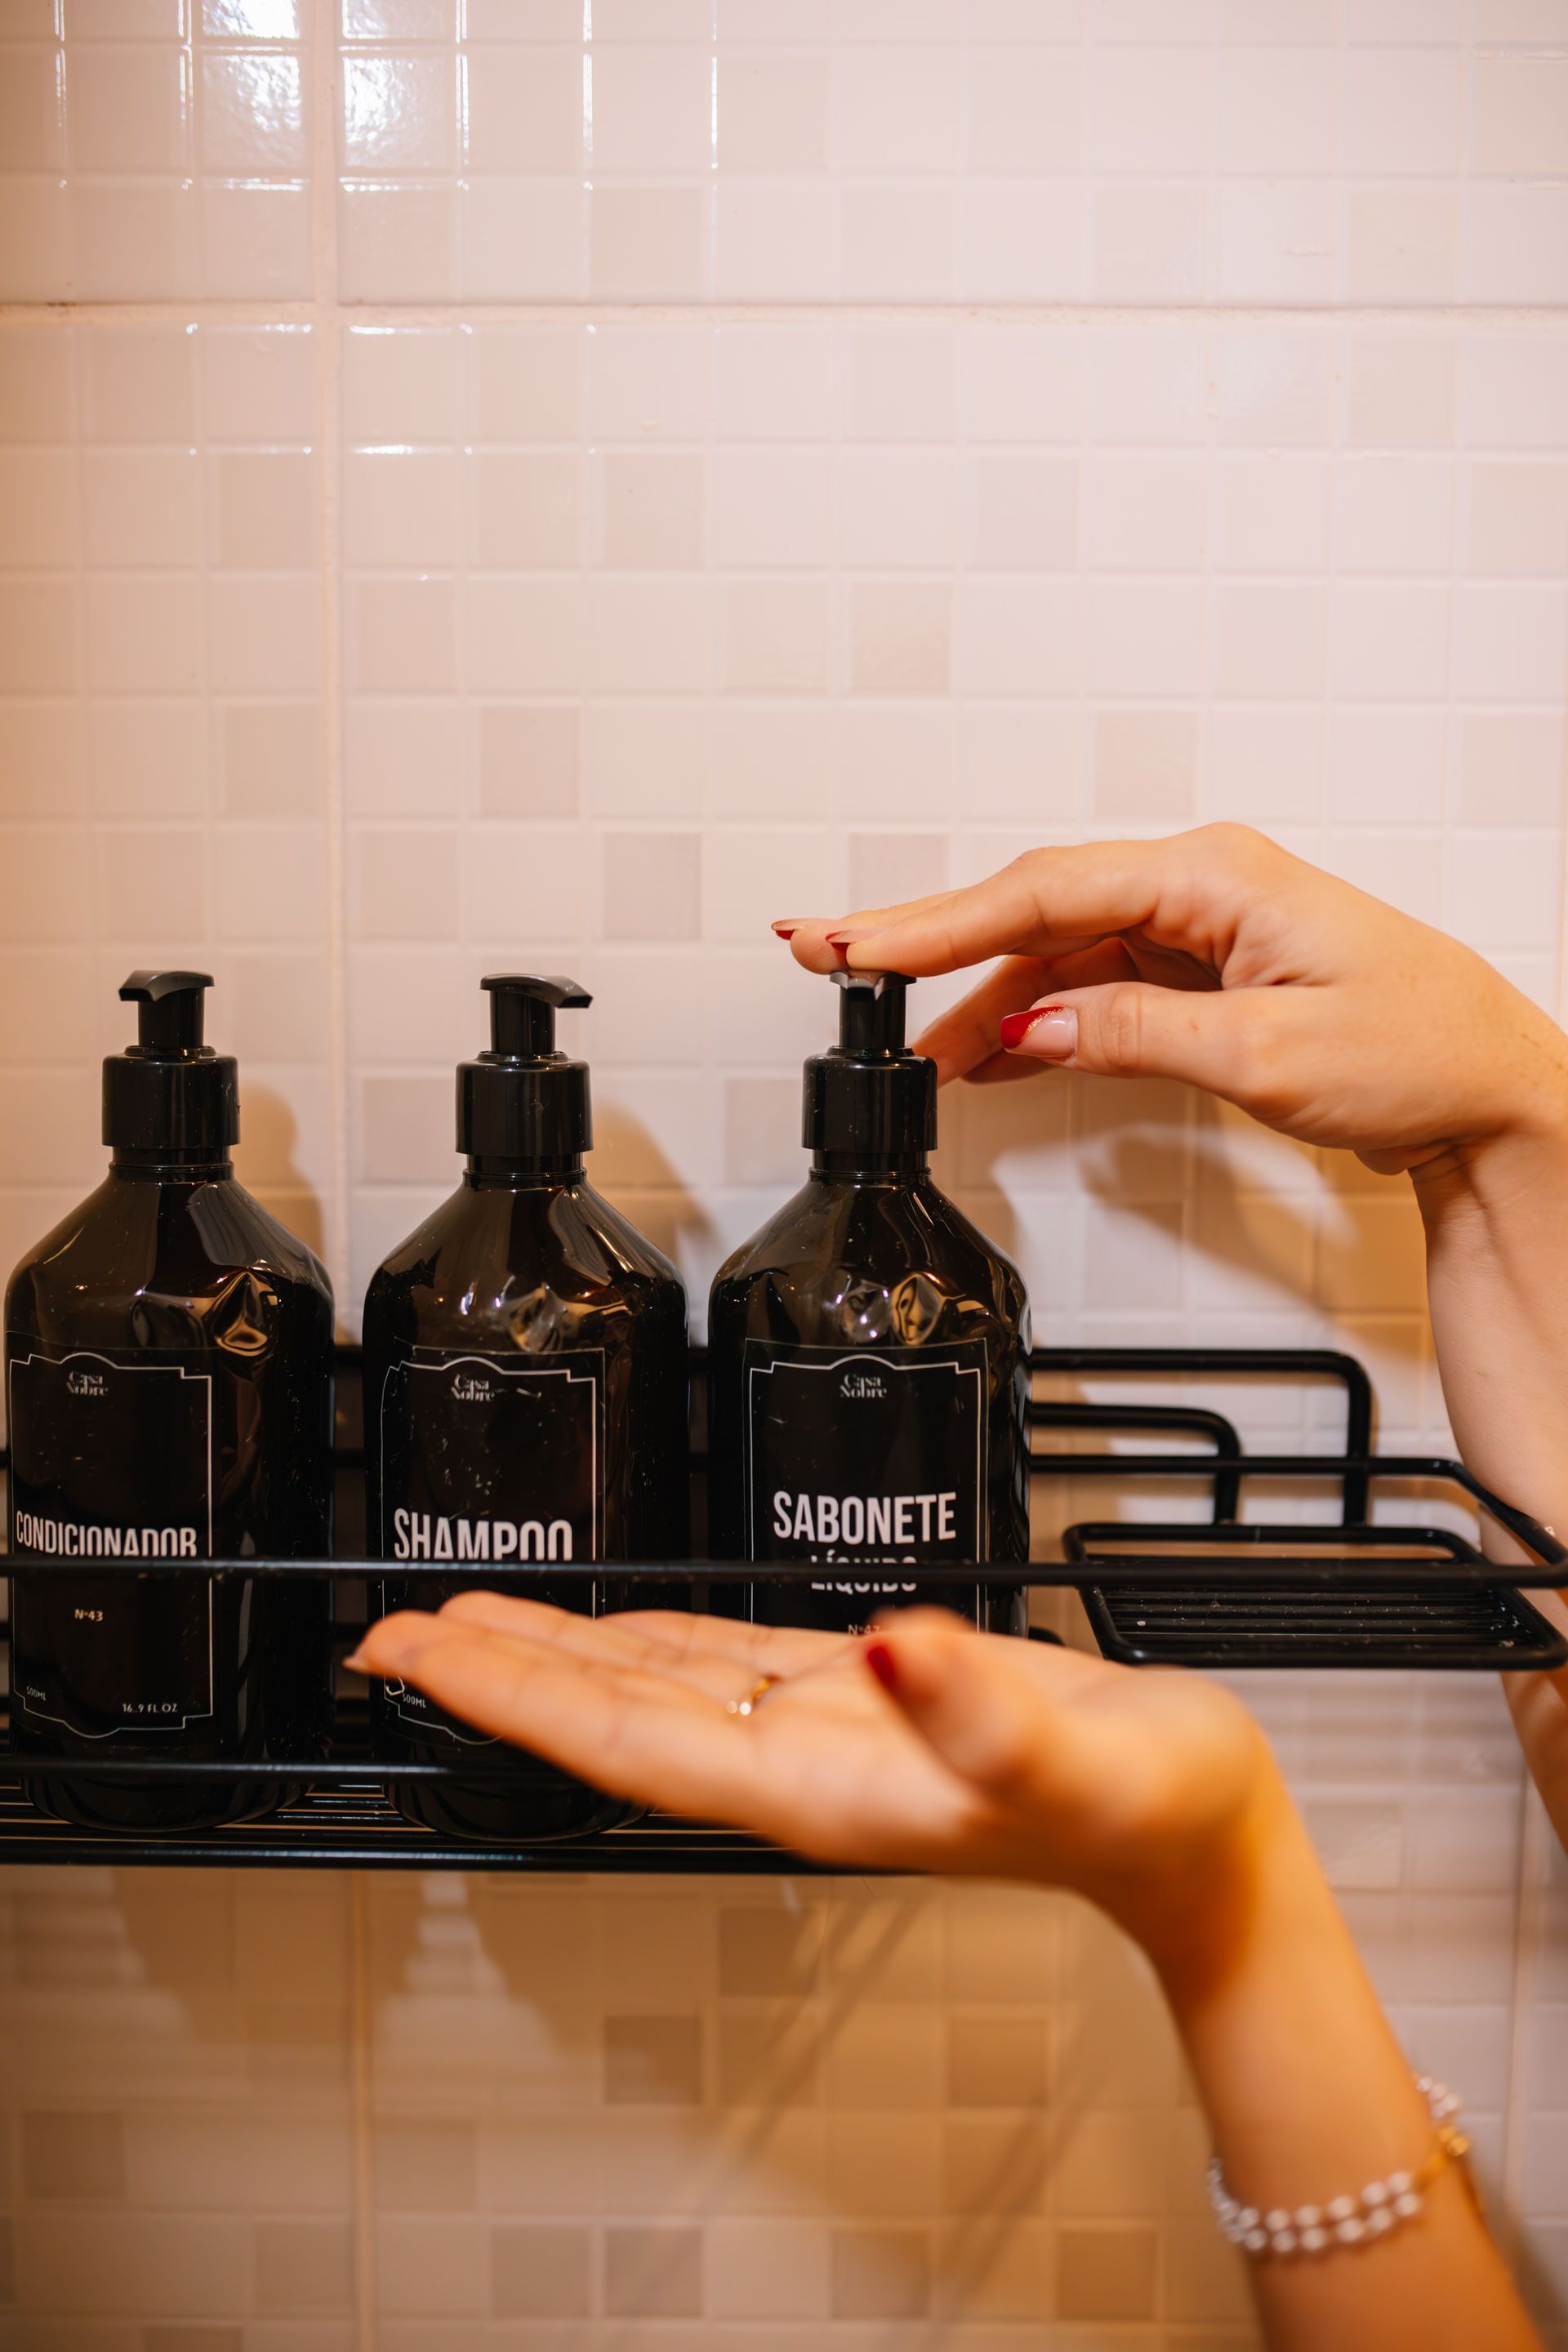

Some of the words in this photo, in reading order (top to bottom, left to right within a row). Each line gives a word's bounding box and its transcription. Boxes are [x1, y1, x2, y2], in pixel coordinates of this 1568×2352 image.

[840, 1384, 887, 1398] Nobre
[844, 1374, 881, 1388] Casa
[773, 1490, 957, 1545] SABONETE
[16, 1510, 198, 1557] CONDICIONADOR
[394, 1508, 572, 1561] SHAMPOO
[403, 1693, 426, 1708] 500ML
